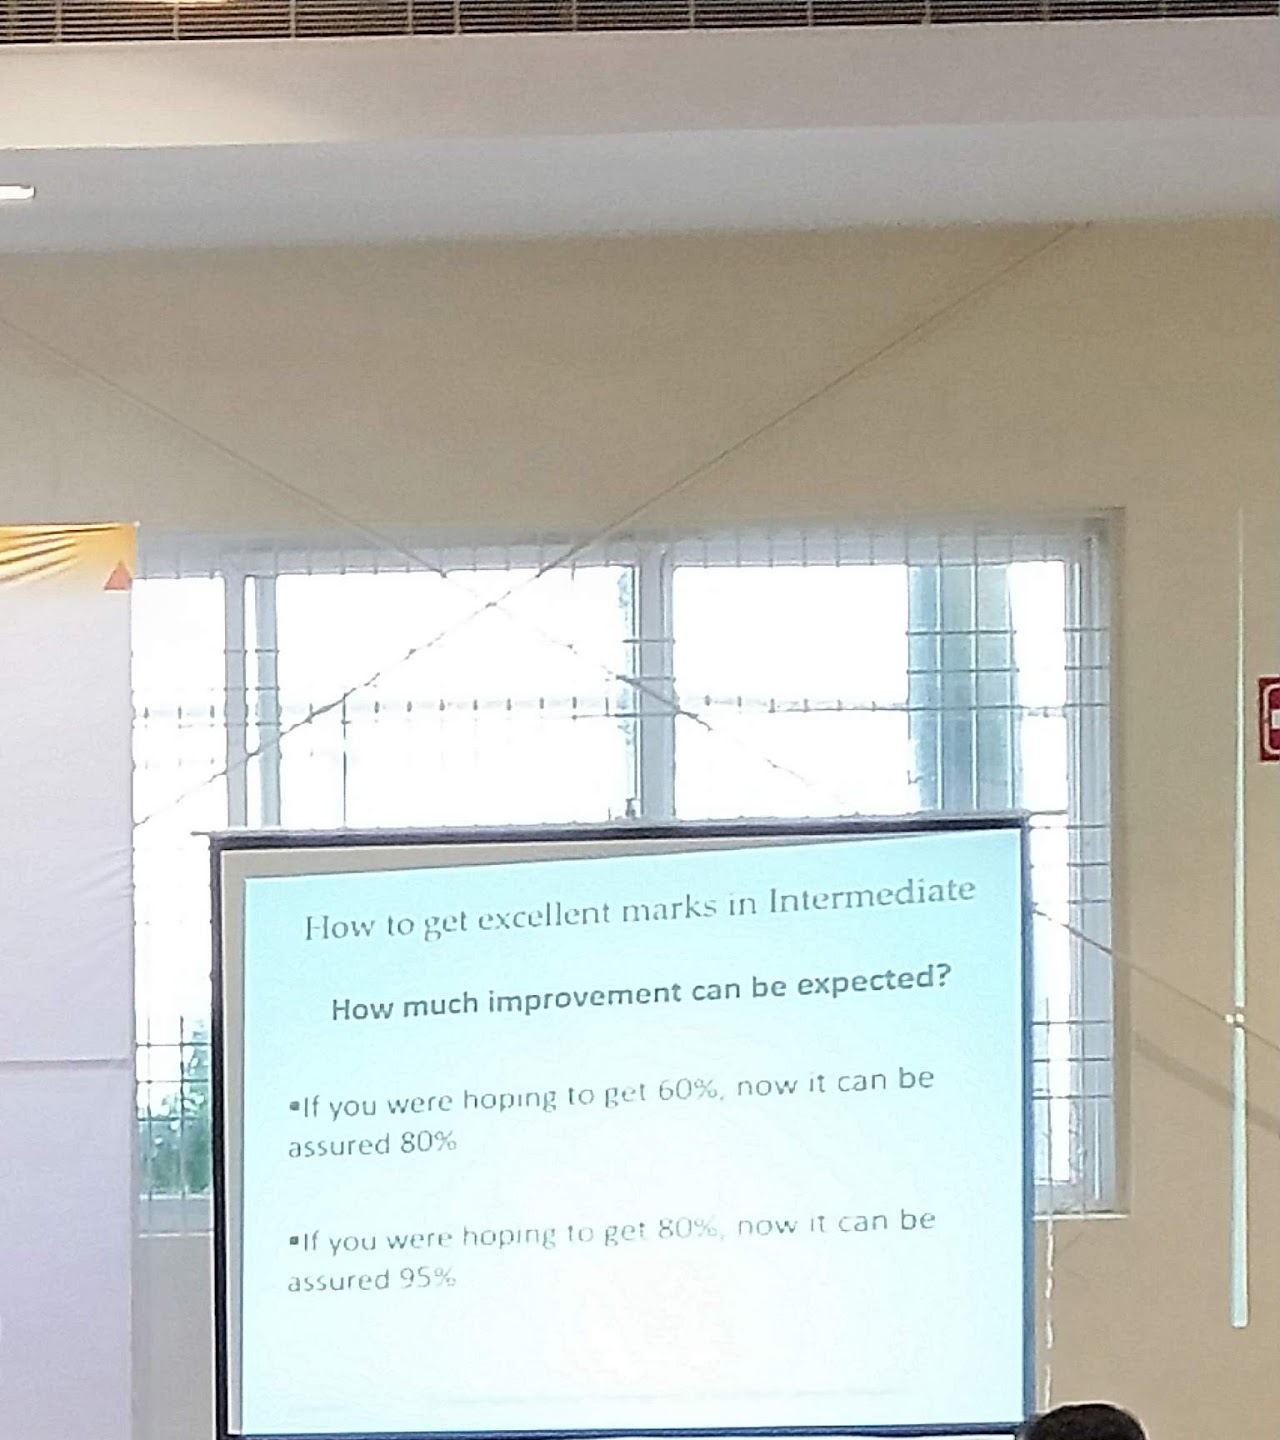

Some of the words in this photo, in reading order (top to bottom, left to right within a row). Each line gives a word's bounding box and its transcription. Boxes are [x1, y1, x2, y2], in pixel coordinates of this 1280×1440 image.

[305, 914, 376, 942] How
[387, 914, 415, 937] to
[424, 910, 468, 943] get
[478, 901, 611, 932] excellent
[621, 893, 718, 923] marks
[728, 892, 758, 917] in
[768, 877, 978, 915] Intermediate
[331, 998, 394, 1021] How
[403, 991, 479, 1018] much
[489, 982, 682, 1016] improvement
[692, 981, 742, 1003] can
[751, 975, 788, 999] be
[796, 962, 953, 999] expected?
[303, 1094, 322, 1118] If
[329, 1099, 378, 1123] you
[386, 1094, 455, 1116] were
[463, 1088, 558, 1114] hoping
[568, 1085, 596, 1106] to
[604, 1083, 647, 1110] get
[658, 1077, 726, 1102] 60%,
[737, 1077, 799, 1098] now
[808, 1073, 827, 1094] it
[838, 1072, 888, 1093] can
[898, 1066, 936, 1090] be
[288, 1132, 391, 1160] assured
[400, 1129, 458, 1155] 80%
[303, 1230, 321, 1252] If
[329, 1234, 378, 1257] you
[386, 1230, 455, 1251] were
[463, 1224, 557, 1251] hoping
[567, 1224, 595, 1243] to
[604, 1220, 646, 1248] get
[737, 1216, 800, 1237] now
[809, 1214, 827, 1234] it
[838, 1213, 889, 1233] can
[899, 1207, 937, 1231] be
[287, 1268, 391, 1293] assured
[399, 1265, 458, 1290] 95%
